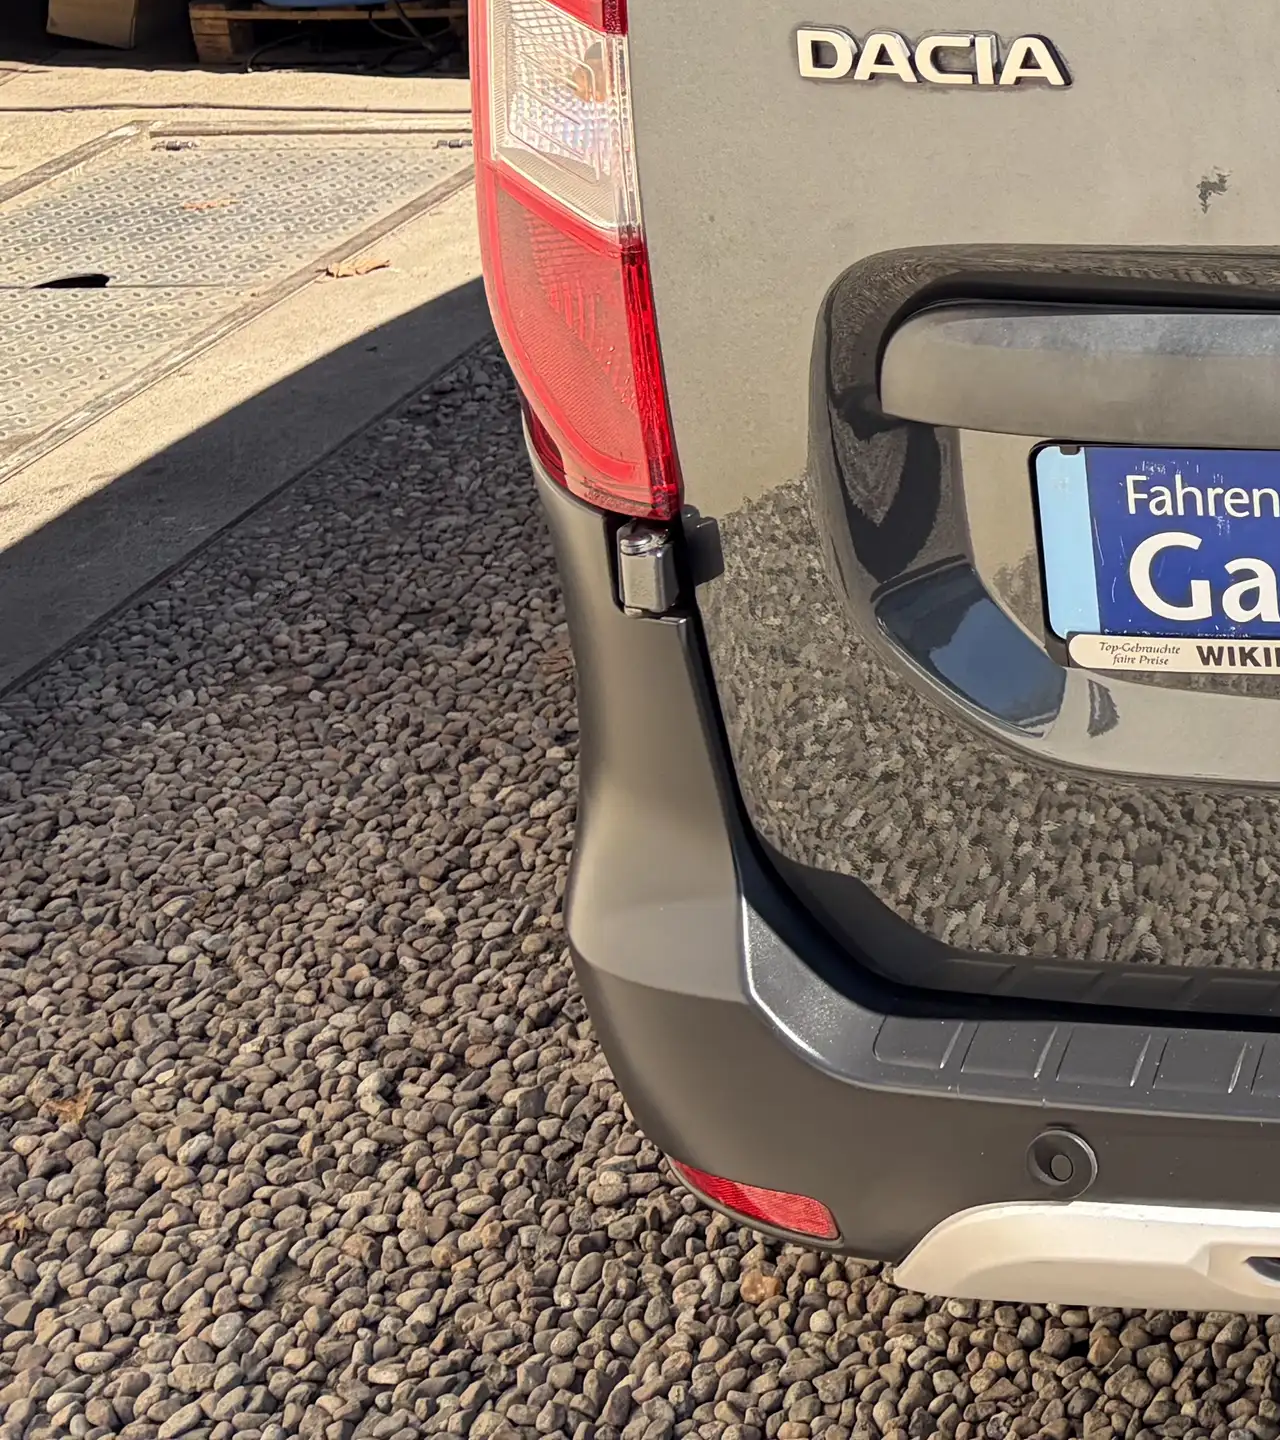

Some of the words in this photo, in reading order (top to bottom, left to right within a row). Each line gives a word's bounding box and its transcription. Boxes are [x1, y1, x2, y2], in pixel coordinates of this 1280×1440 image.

[797, 27, 1073, 89] DACIA
[1125, 474, 1280, 518] Fahren
[1099, 641, 1181, 655] Top-Gebrauchte
